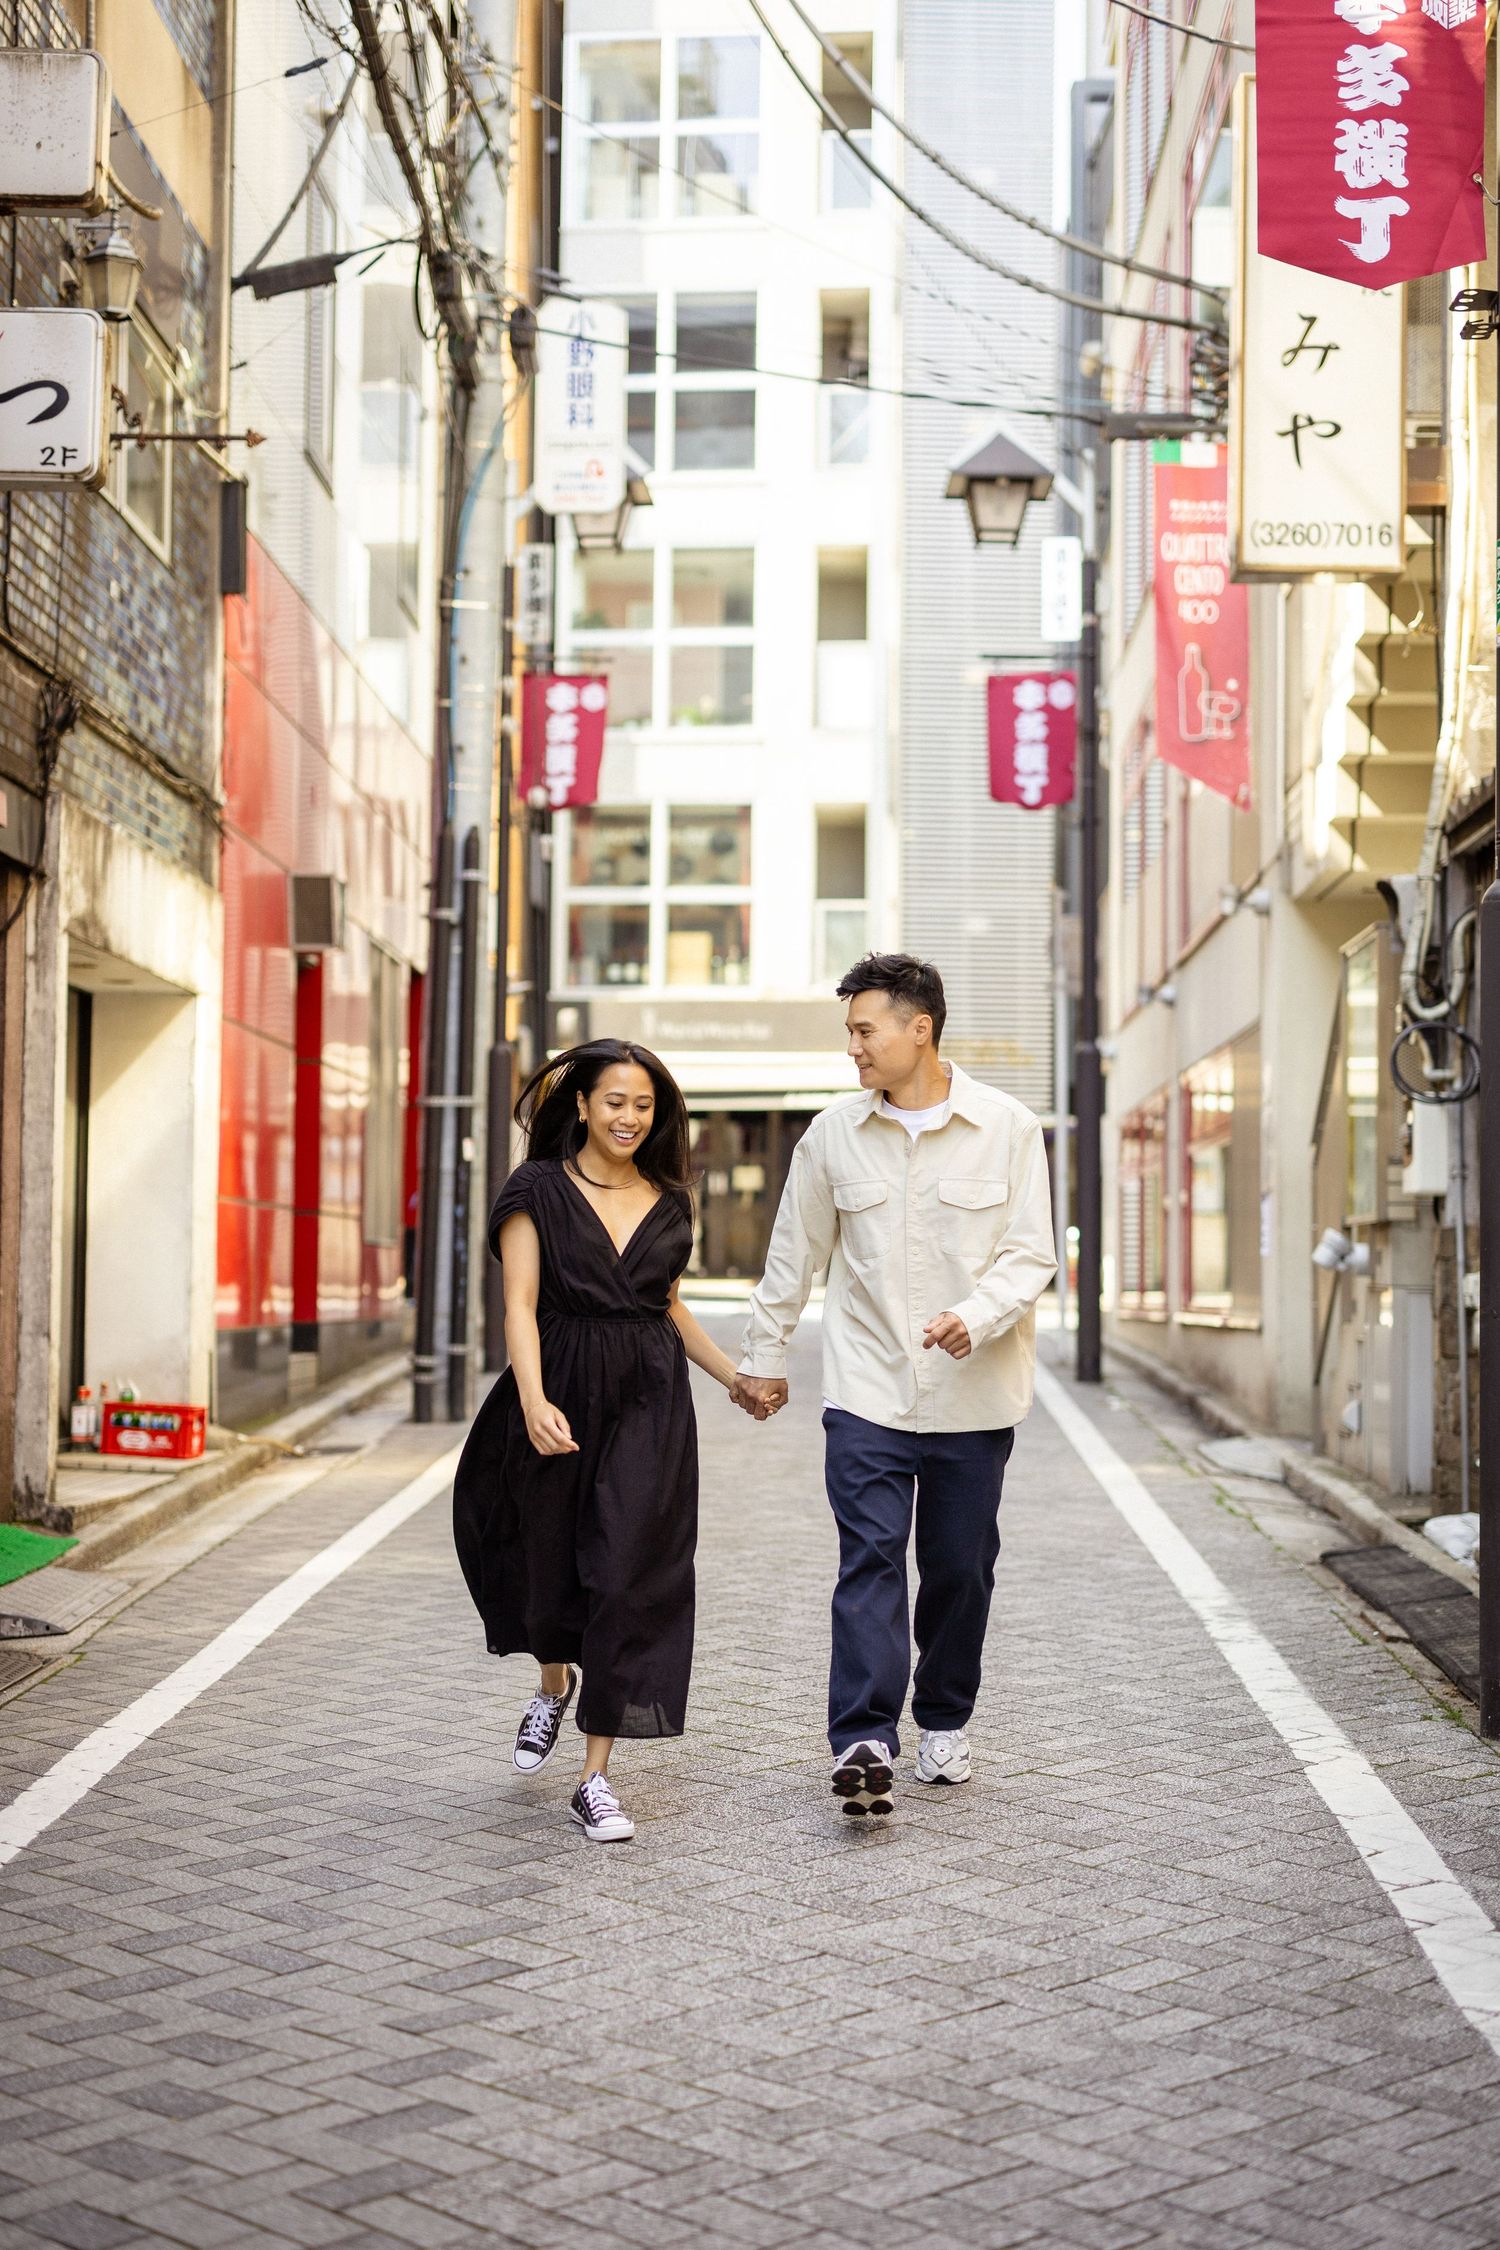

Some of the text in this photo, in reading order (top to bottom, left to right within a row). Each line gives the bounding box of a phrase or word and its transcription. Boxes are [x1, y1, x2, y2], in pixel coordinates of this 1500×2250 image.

[1276, 312, 1342, 469] みや
[40, 446, 78, 467] 2F
[1161, 531, 1230, 567] QUATTR
[1249, 519, 1394, 549] (3260)7016
